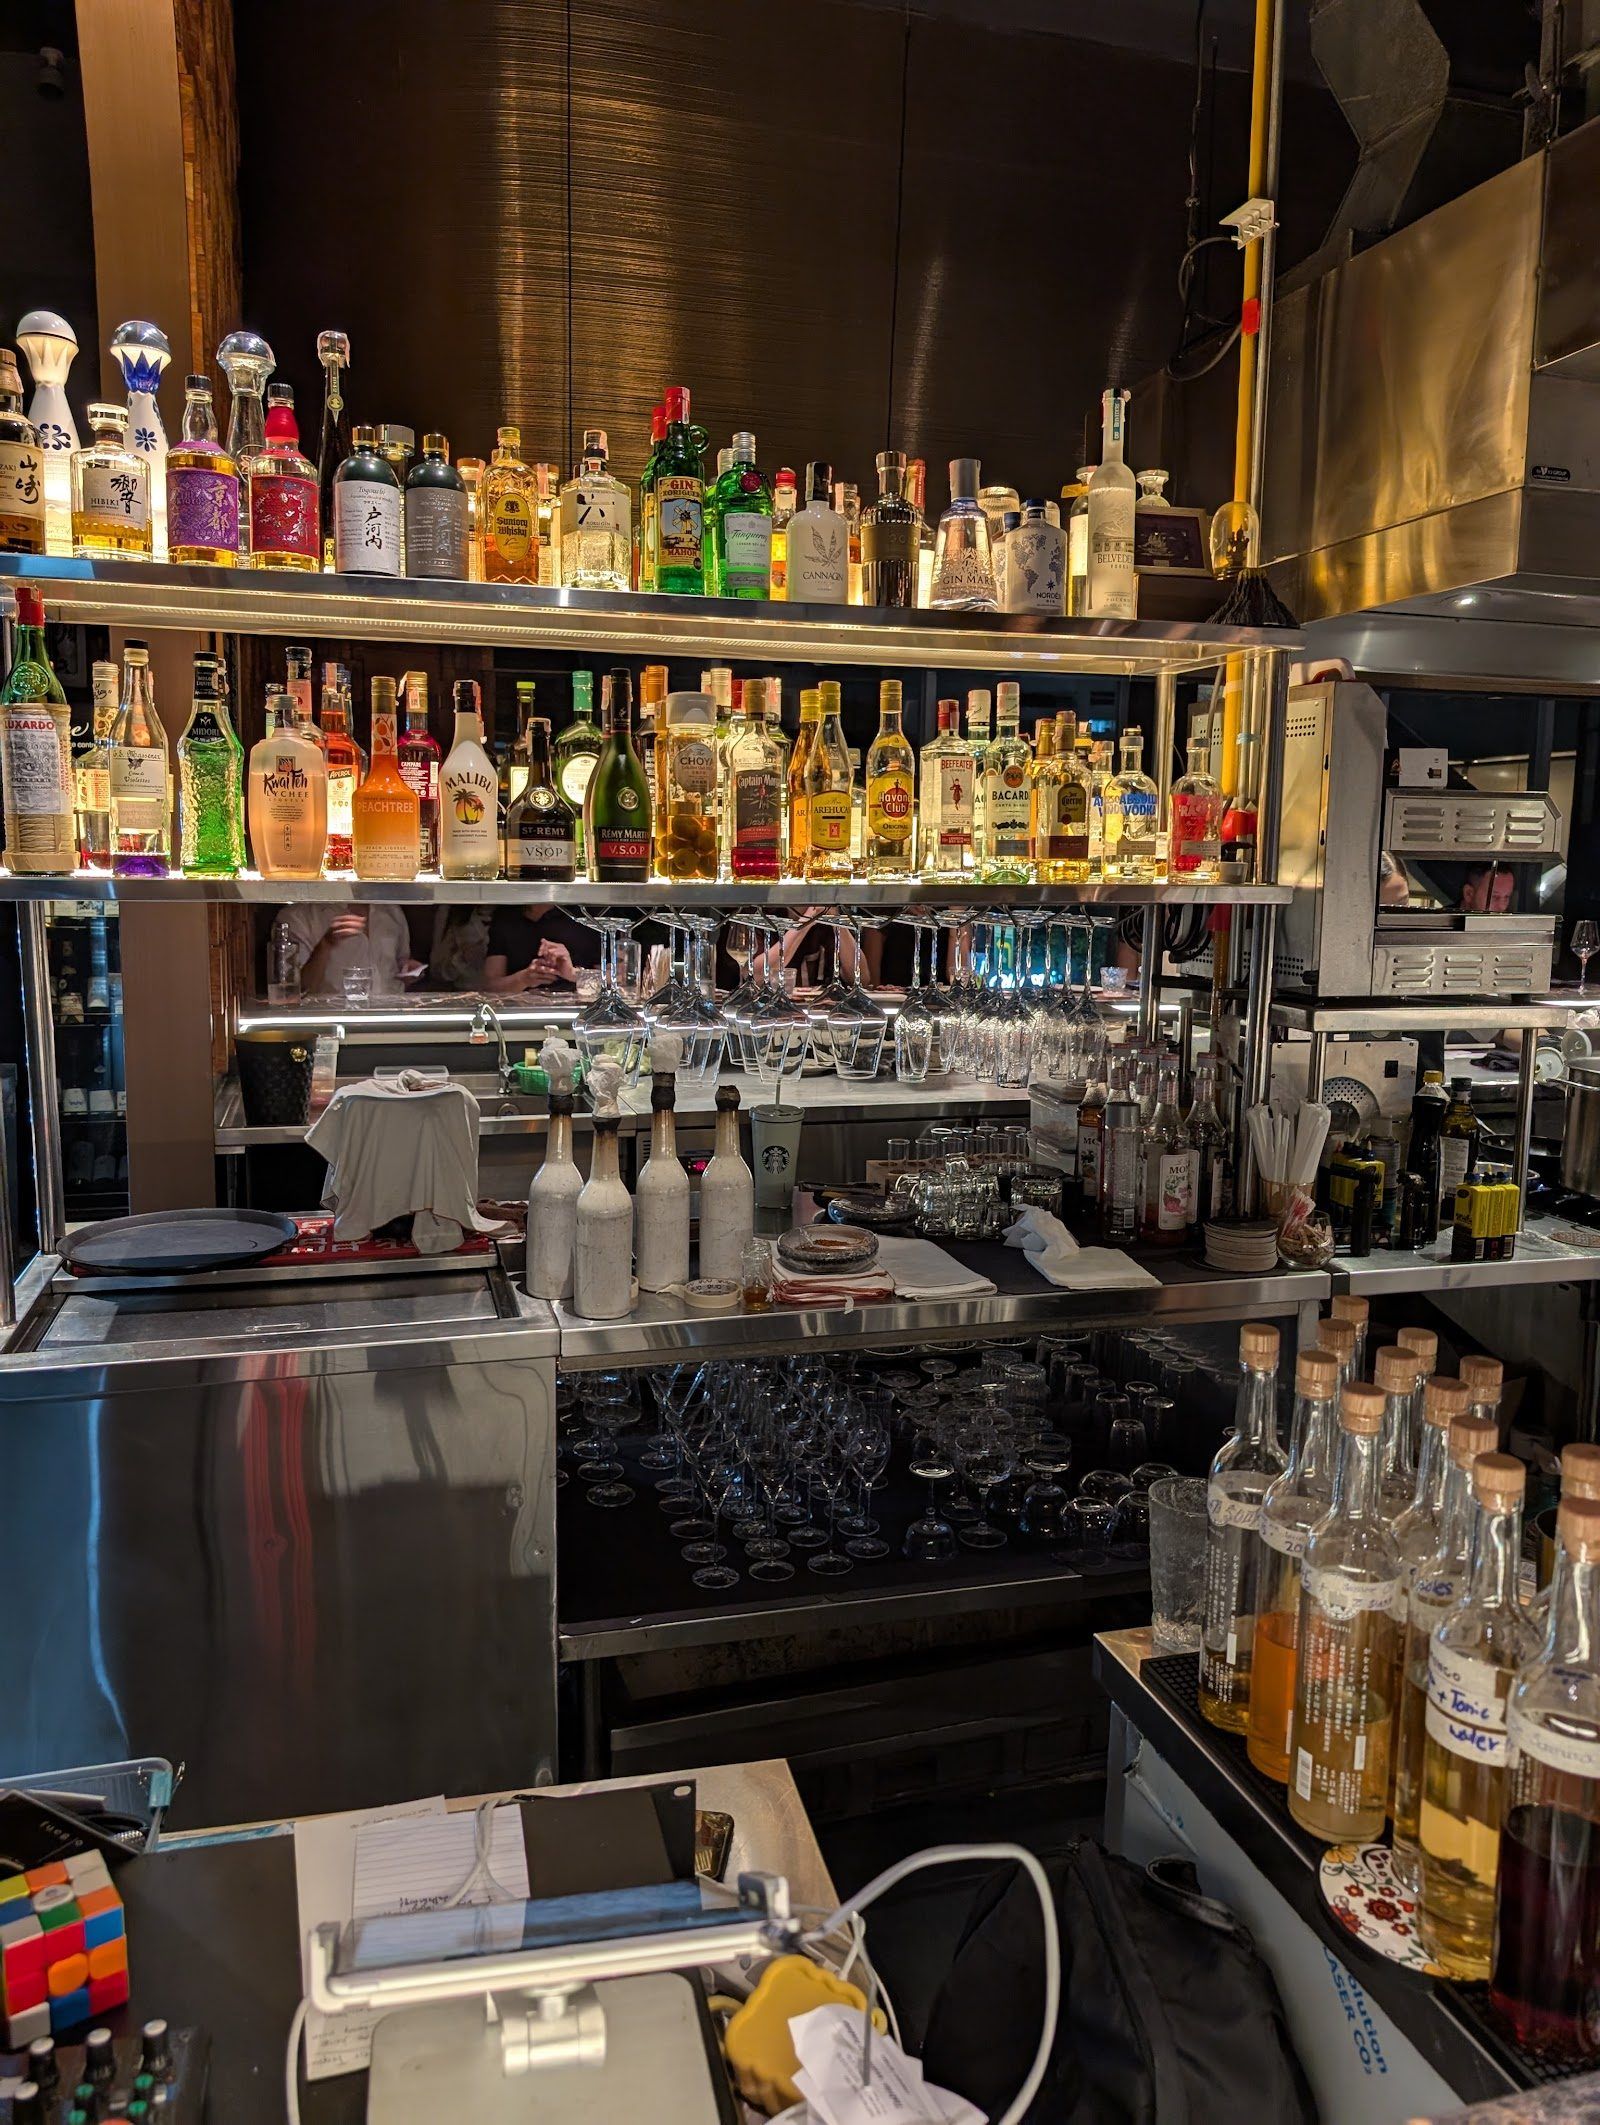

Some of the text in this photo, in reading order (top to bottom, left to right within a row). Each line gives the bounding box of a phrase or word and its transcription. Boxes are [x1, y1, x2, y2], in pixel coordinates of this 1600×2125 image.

[669, 479, 694, 491] GIN
[90, 497, 120, 507] HIBIKI
[496, 516, 529, 528] Suntory
[498, 526, 527, 538] Whisky
[942, 575, 963, 585] GIN
[4, 720, 56, 730] LUXARDO
[191, 728, 220, 736] MIDORI
[941, 759, 974, 770] BEEFEATER
[263, 768, 308, 795] Kwai Feh
[445, 771, 494, 794] MALIBU
[738, 775, 763, 788] Captain
[357, 801, 414, 813] PEACHTREE
[886, 803, 907, 813] Club
[525, 847, 563, 859] VSOP
